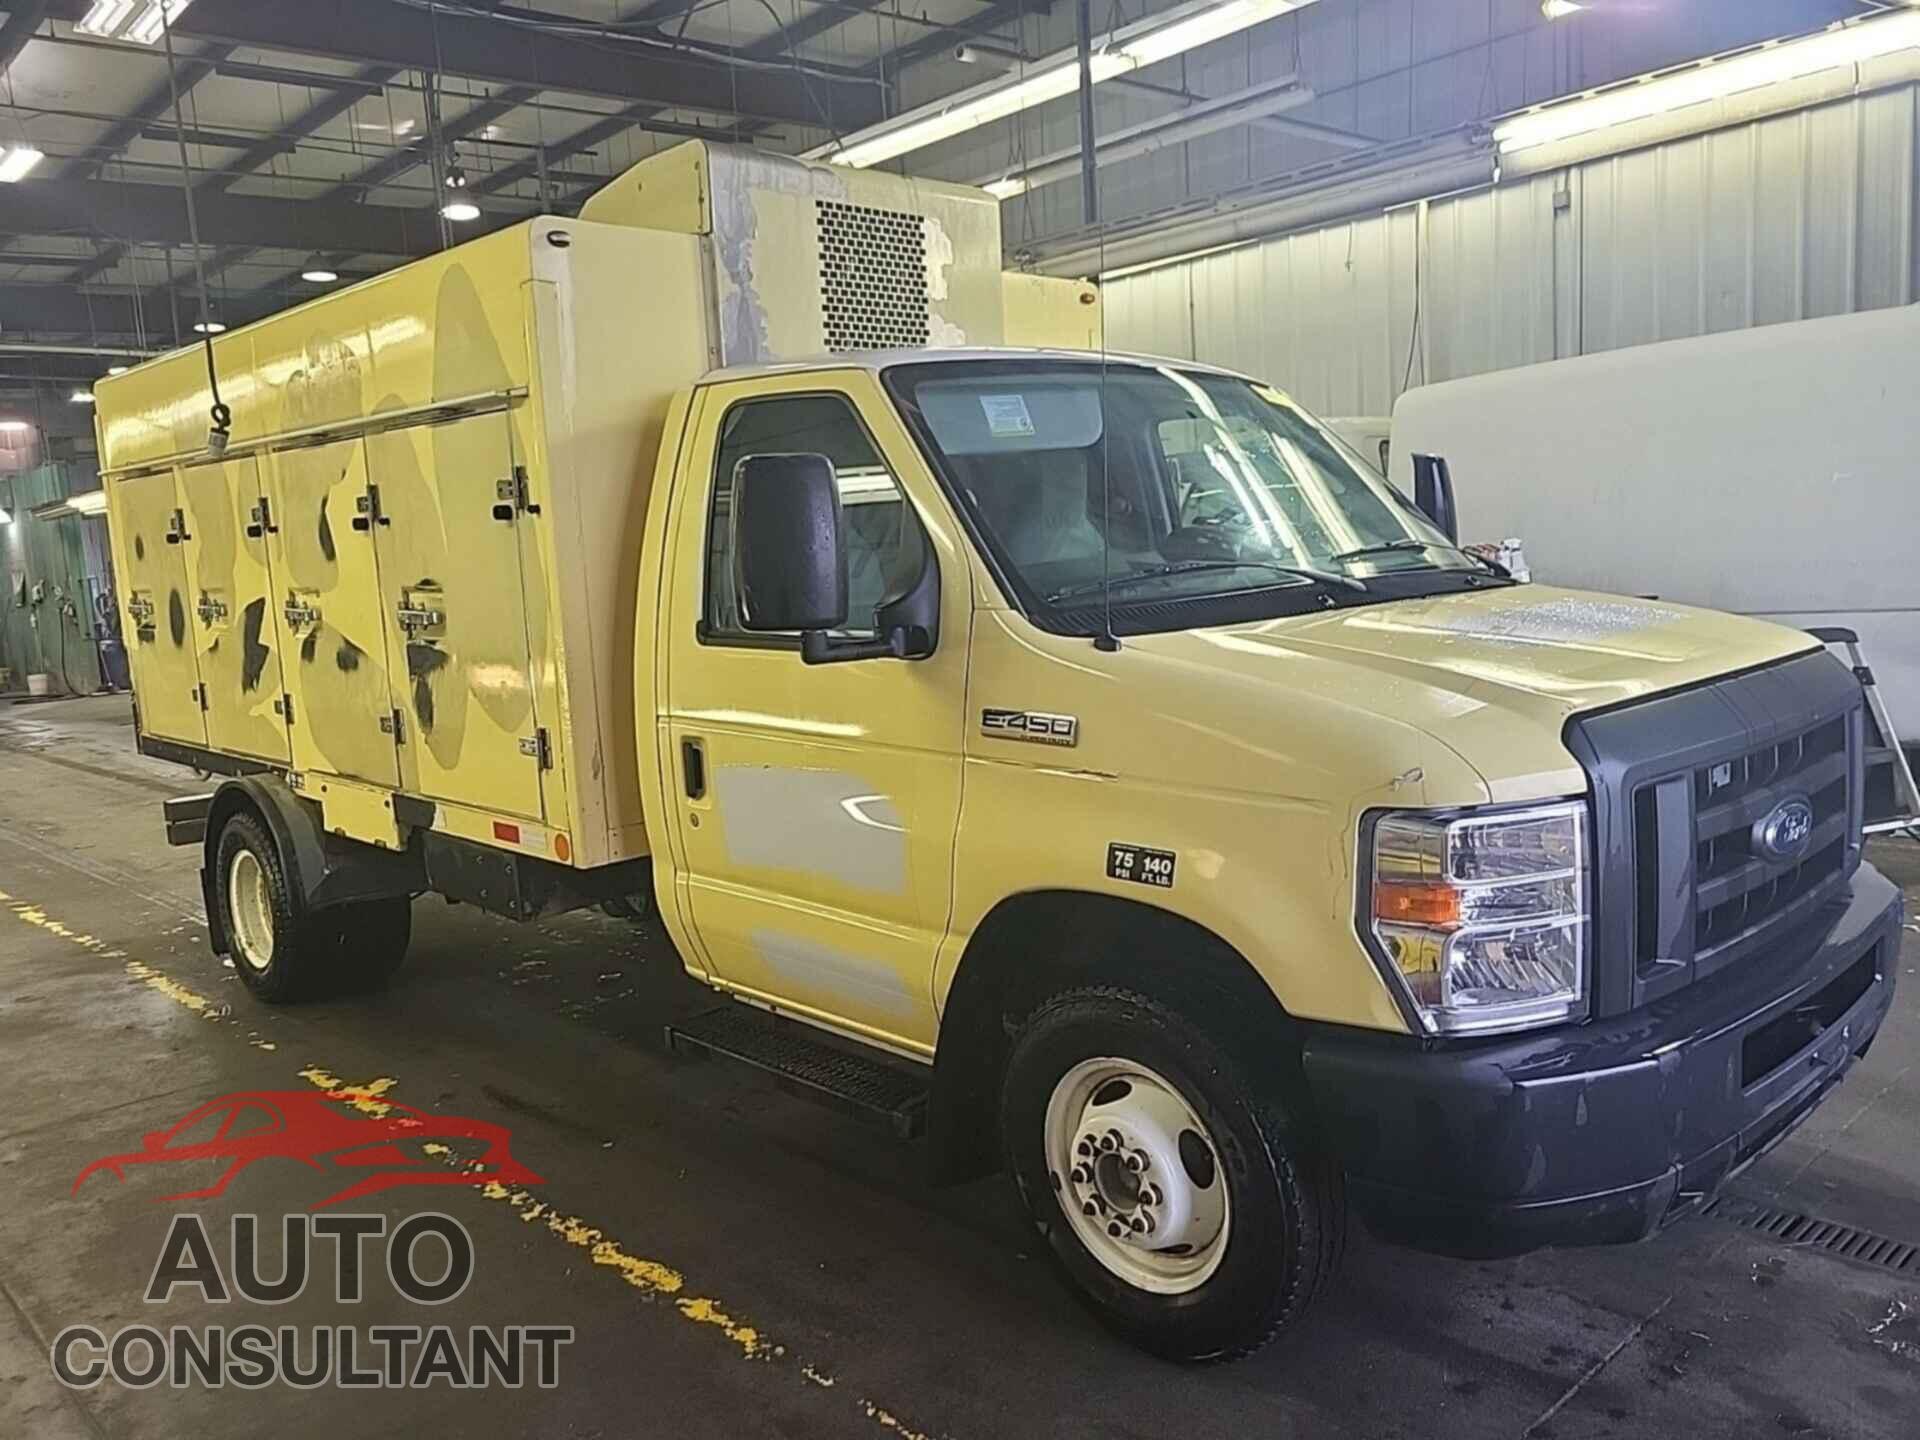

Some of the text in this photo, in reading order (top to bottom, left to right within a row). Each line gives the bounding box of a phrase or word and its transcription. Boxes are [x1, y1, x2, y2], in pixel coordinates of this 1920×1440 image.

[1114, 850, 1134, 868] 75
[1143, 856, 1172, 875] 140
[1115, 867, 1130, 879] PSI
